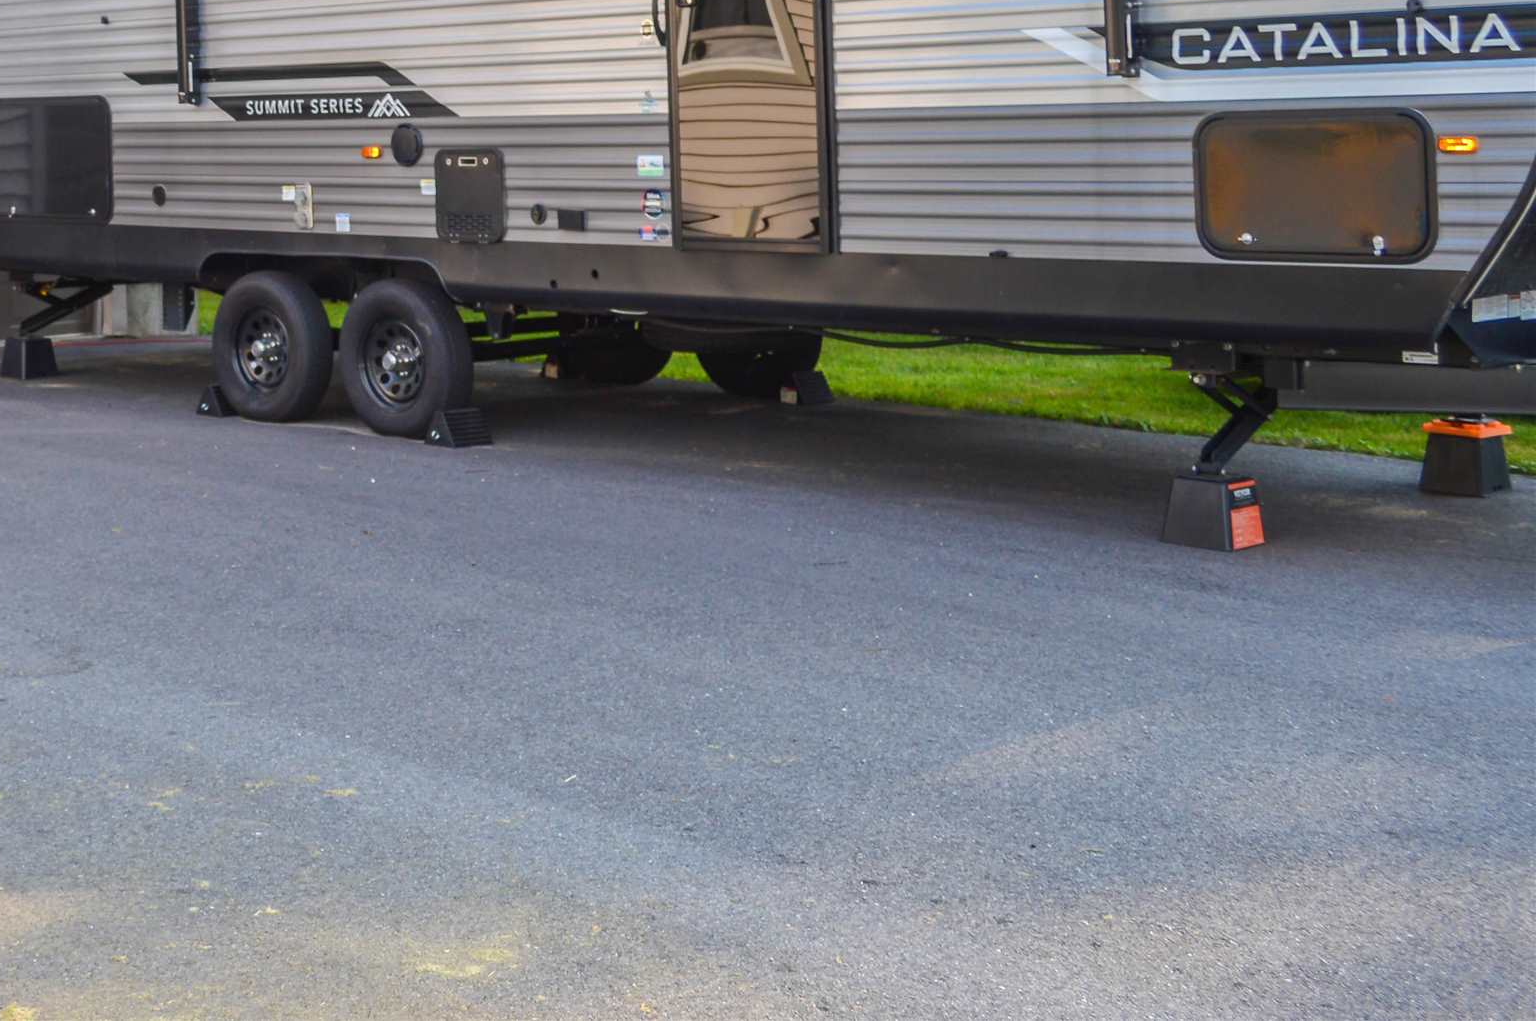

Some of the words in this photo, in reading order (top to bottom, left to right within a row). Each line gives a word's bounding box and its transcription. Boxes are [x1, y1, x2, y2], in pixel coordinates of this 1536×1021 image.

[1171, 12, 1522, 66] CATALINA
[245, 99, 305, 116] SUMMIT
[309, 97, 364, 115] SERIES
